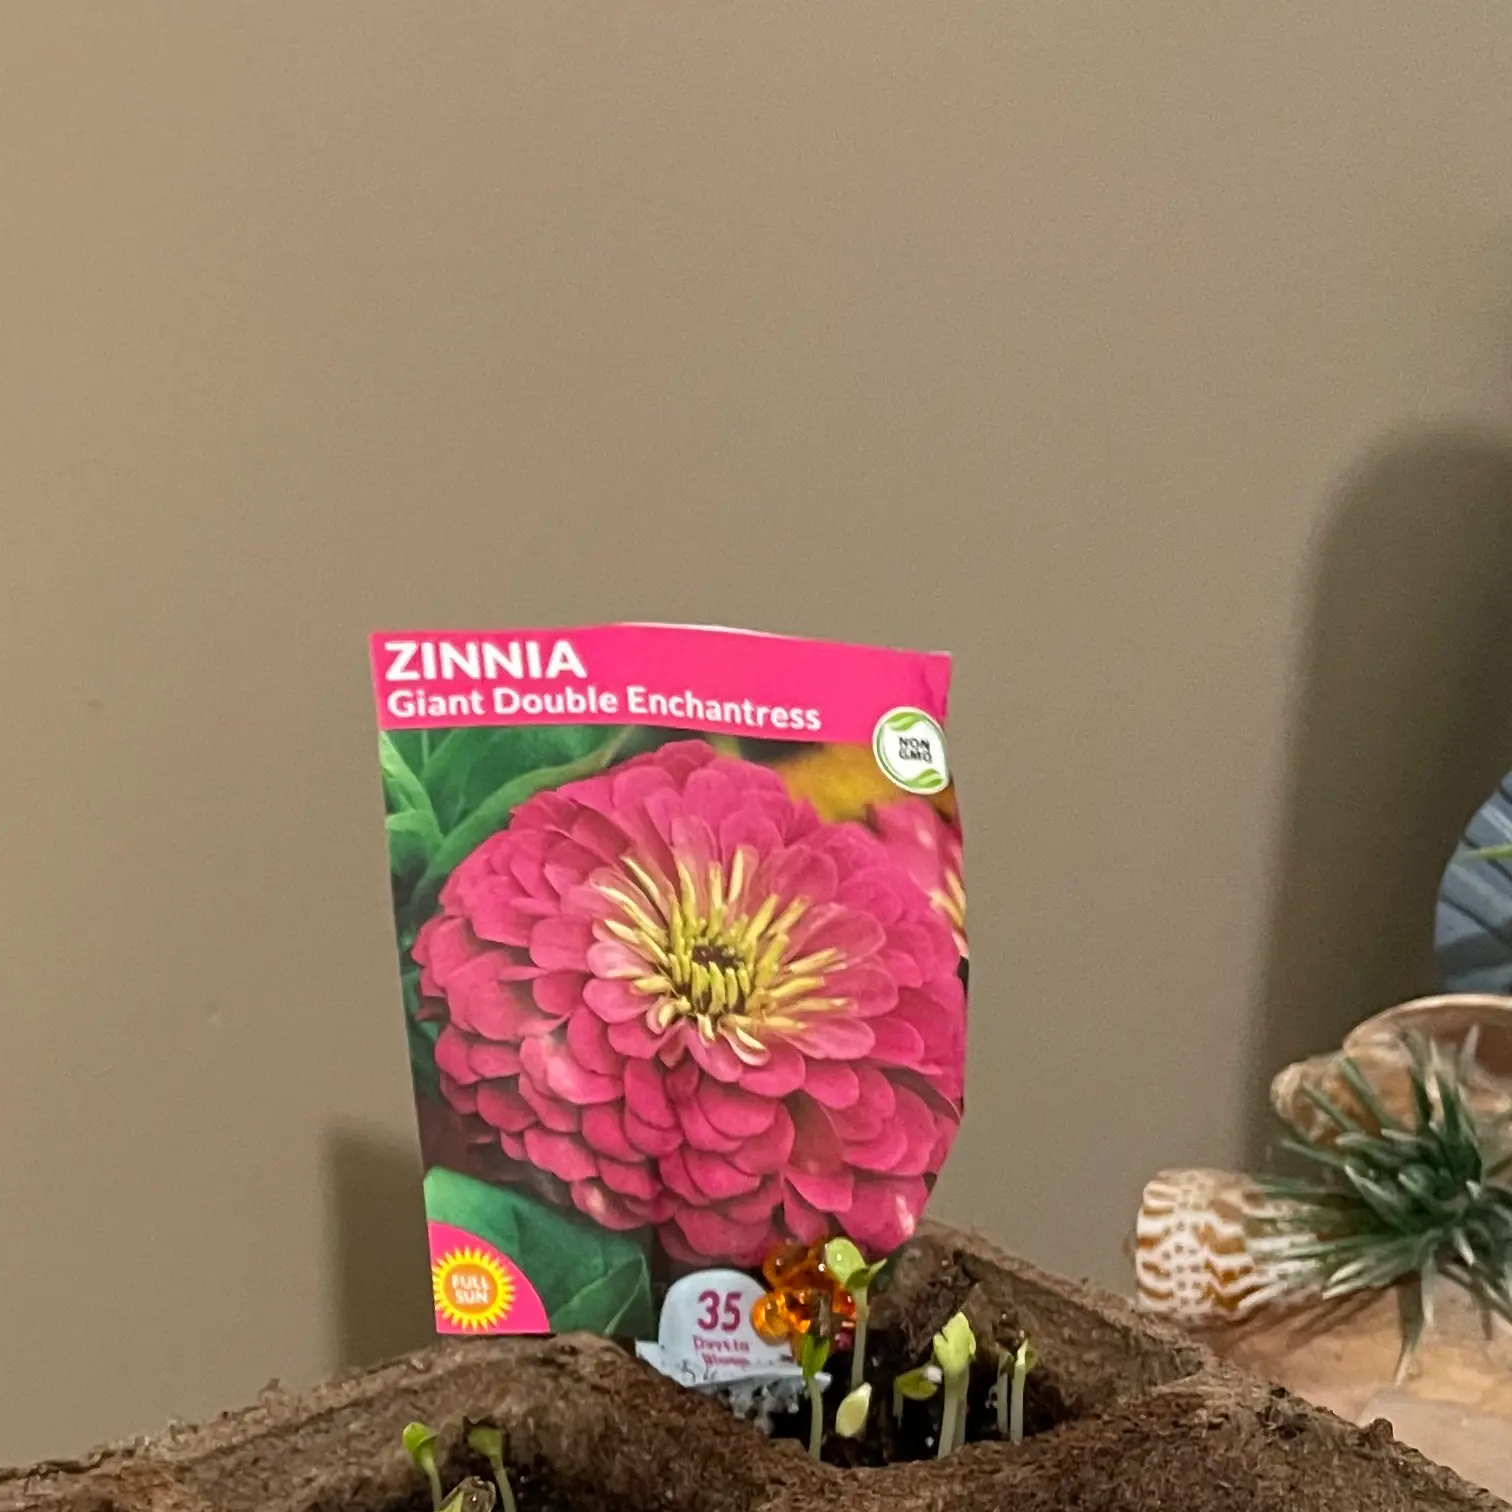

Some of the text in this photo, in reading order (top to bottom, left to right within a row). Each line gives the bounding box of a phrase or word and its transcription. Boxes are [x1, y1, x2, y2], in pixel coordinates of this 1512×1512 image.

[384, 640, 588, 681] ZINNIA
[388, 685, 823, 731] Giant Double Enchantress
[898, 736, 931, 750] NON
[898, 747, 933, 763] GMO
[451, 1273, 489, 1291] FULL
[455, 1289, 489, 1305] SUN
[696, 1289, 743, 1333] 35
